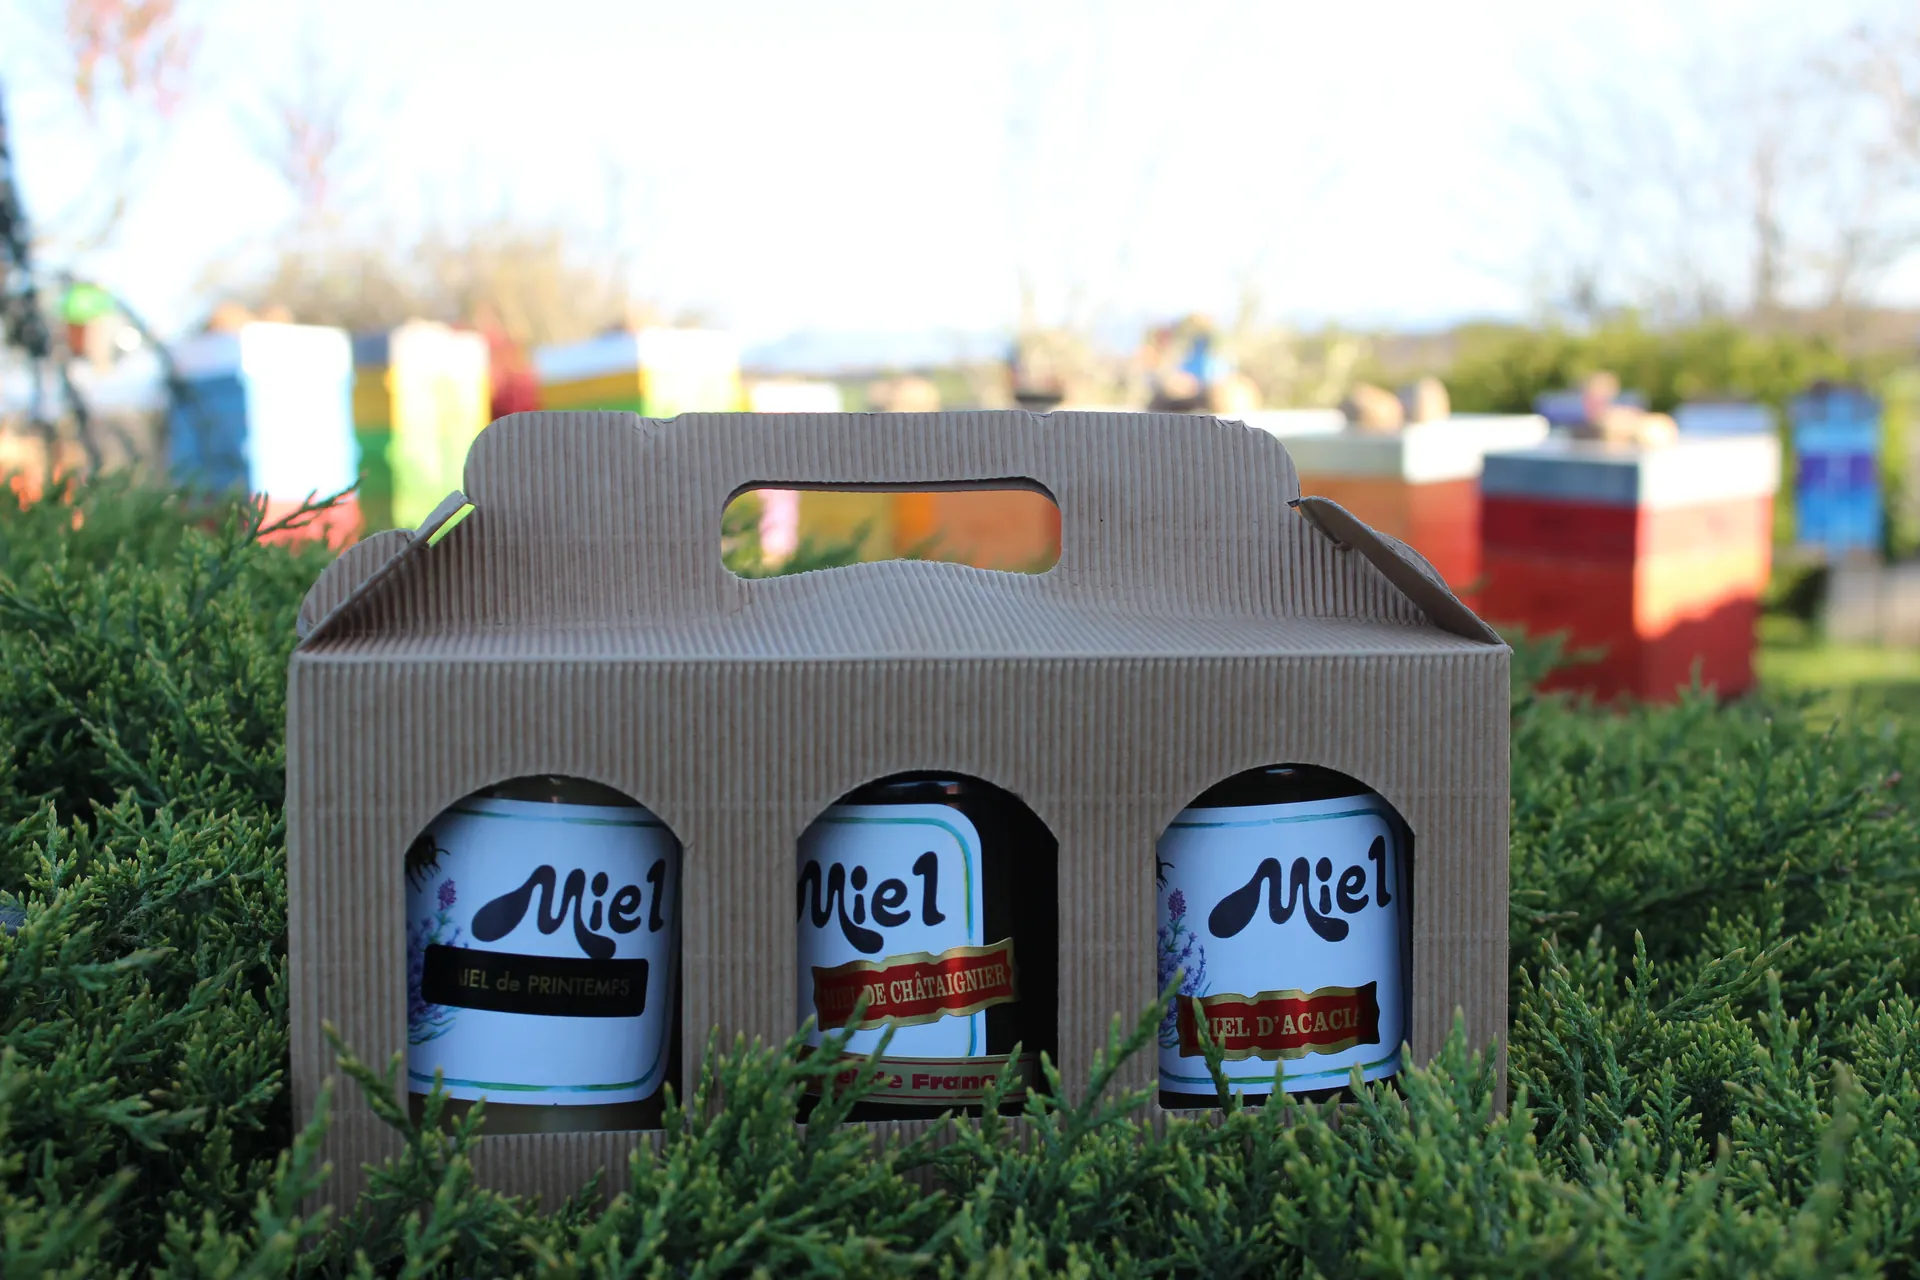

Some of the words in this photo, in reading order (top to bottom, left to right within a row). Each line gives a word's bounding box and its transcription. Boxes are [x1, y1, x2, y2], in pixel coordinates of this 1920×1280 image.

[496, 970, 521, 992] de
[527, 974, 630, 998] PRINTEMPS
[889, 963, 1007, 1004] CHÂTAIGNIER
[1207, 1016, 1251, 1038] IEL
